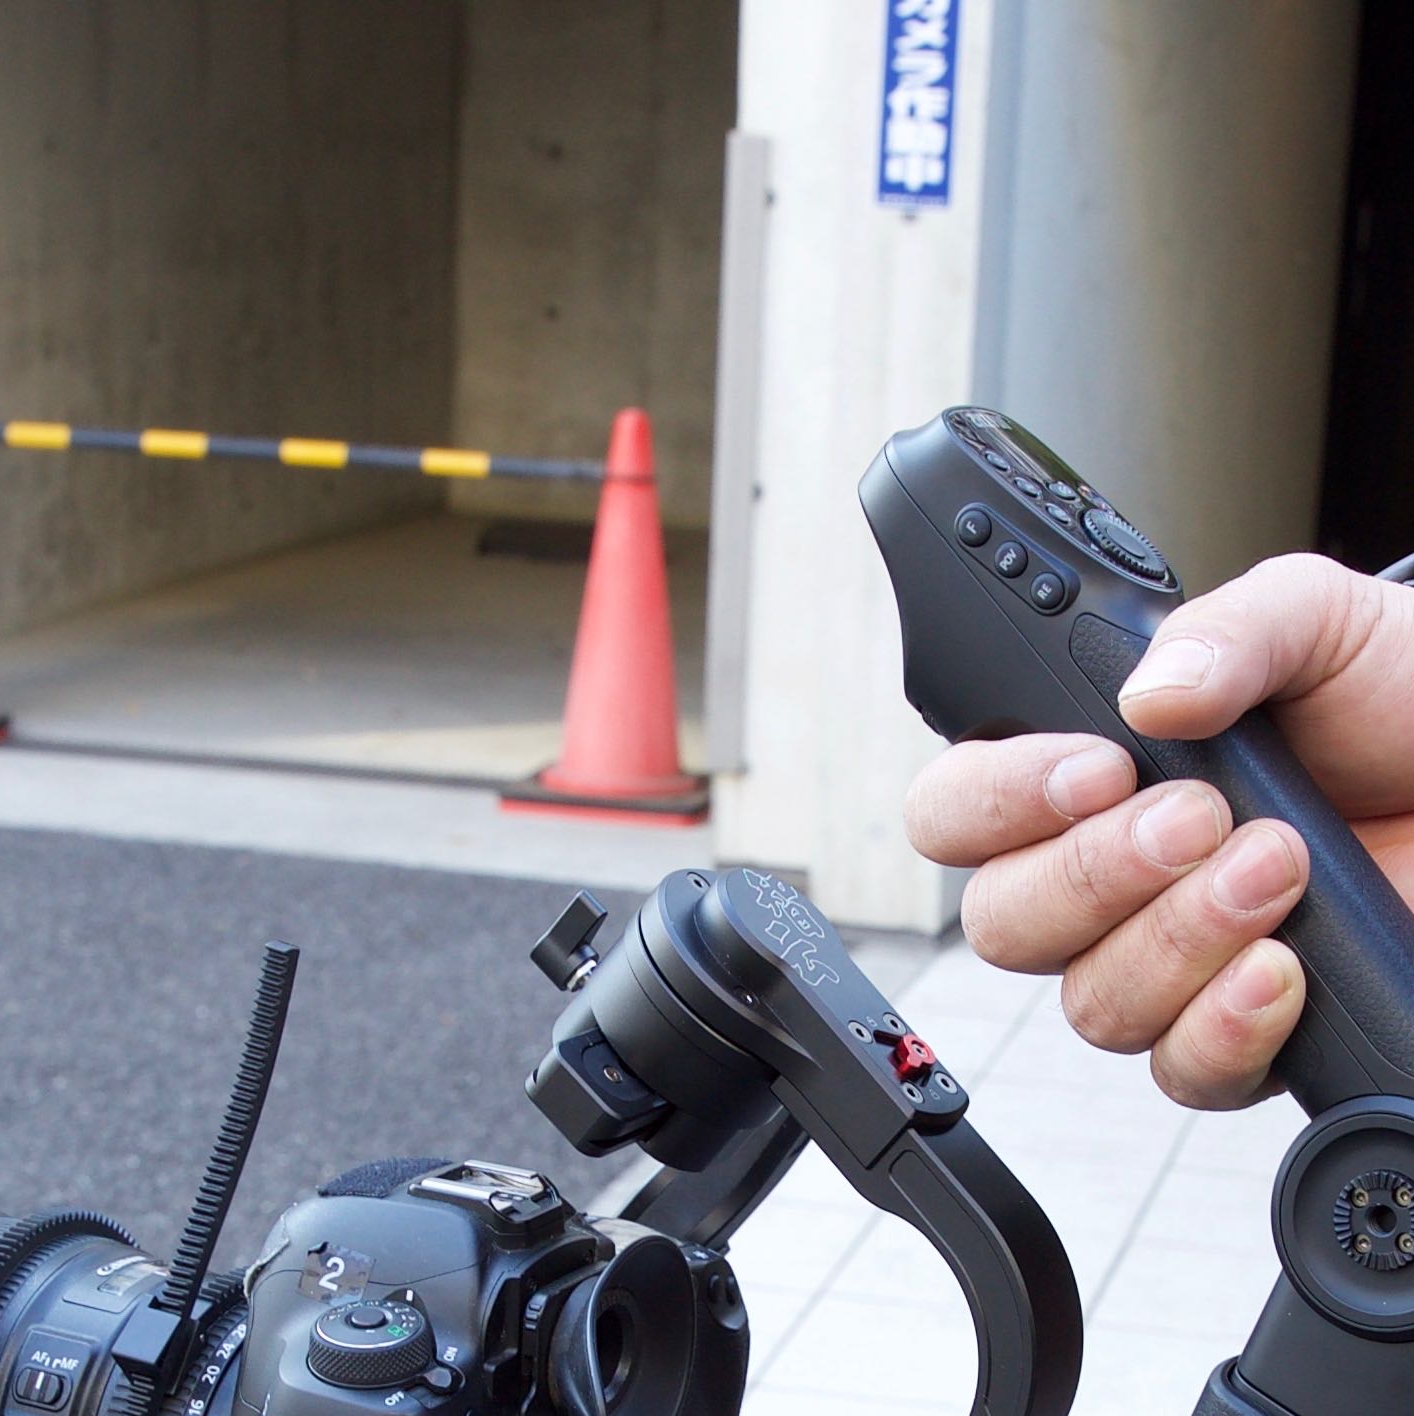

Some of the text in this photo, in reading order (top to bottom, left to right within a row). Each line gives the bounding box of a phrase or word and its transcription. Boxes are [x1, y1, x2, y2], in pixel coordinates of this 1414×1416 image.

[965, 520, 978, 535] F
[999, 548, 1019, 572] POV
[1037, 582, 1053, 600] RE
[318, 1256, 346, 1292] 2
[31, 1350, 80, 1371] AF MF
[443, 1346, 459, 1362] ON
[188, 1398, 205, 1416] 16
[202, 1364, 221, 1385] 20
[216, 1342, 236, 1360] 24
